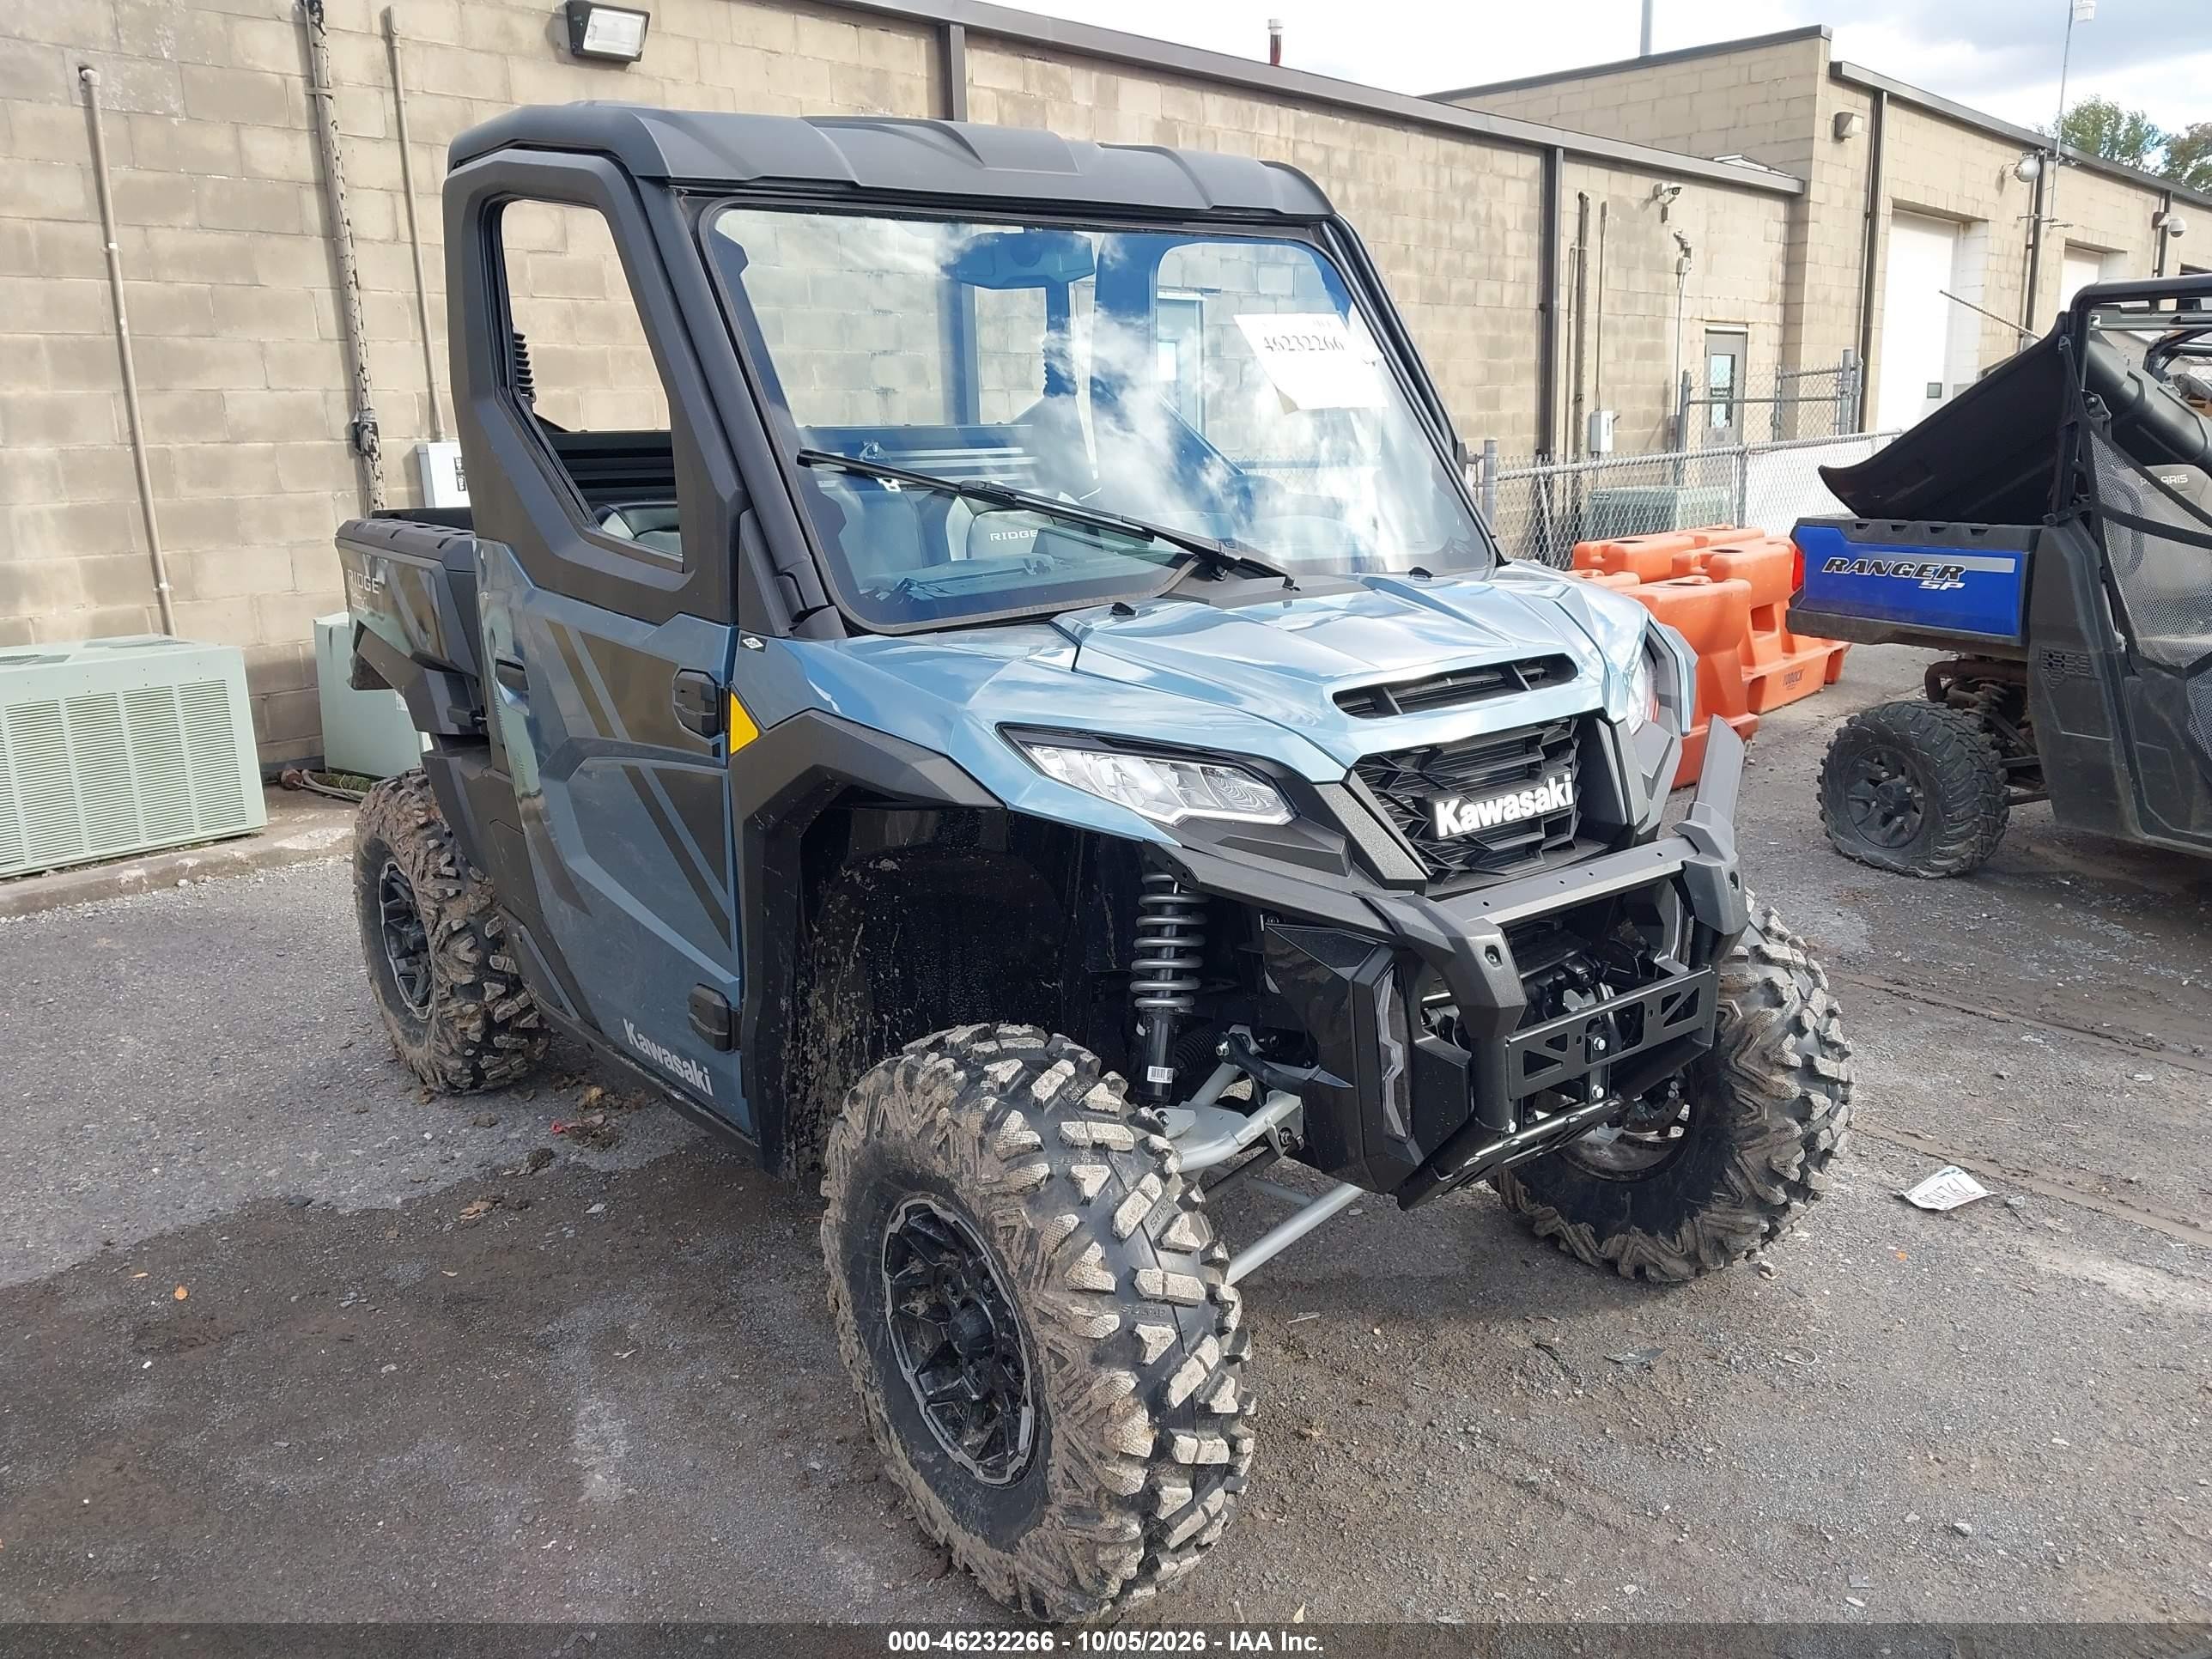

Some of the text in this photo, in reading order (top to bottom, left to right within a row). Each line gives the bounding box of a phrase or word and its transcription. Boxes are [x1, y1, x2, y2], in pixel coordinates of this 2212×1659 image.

[1264, 334, 1345, 352] 46232266
[2139, 473, 2189, 487] PARIS
[989, 529, 1038, 541] RIDGE
[1821, 556, 1966, 581] RANGER
[347, 569, 380, 595] RIDGE
[1917, 580, 1966, 591] SP
[1435, 773, 1574, 837] Kawasaki
[623, 1017, 714, 1097] Kawasaki
